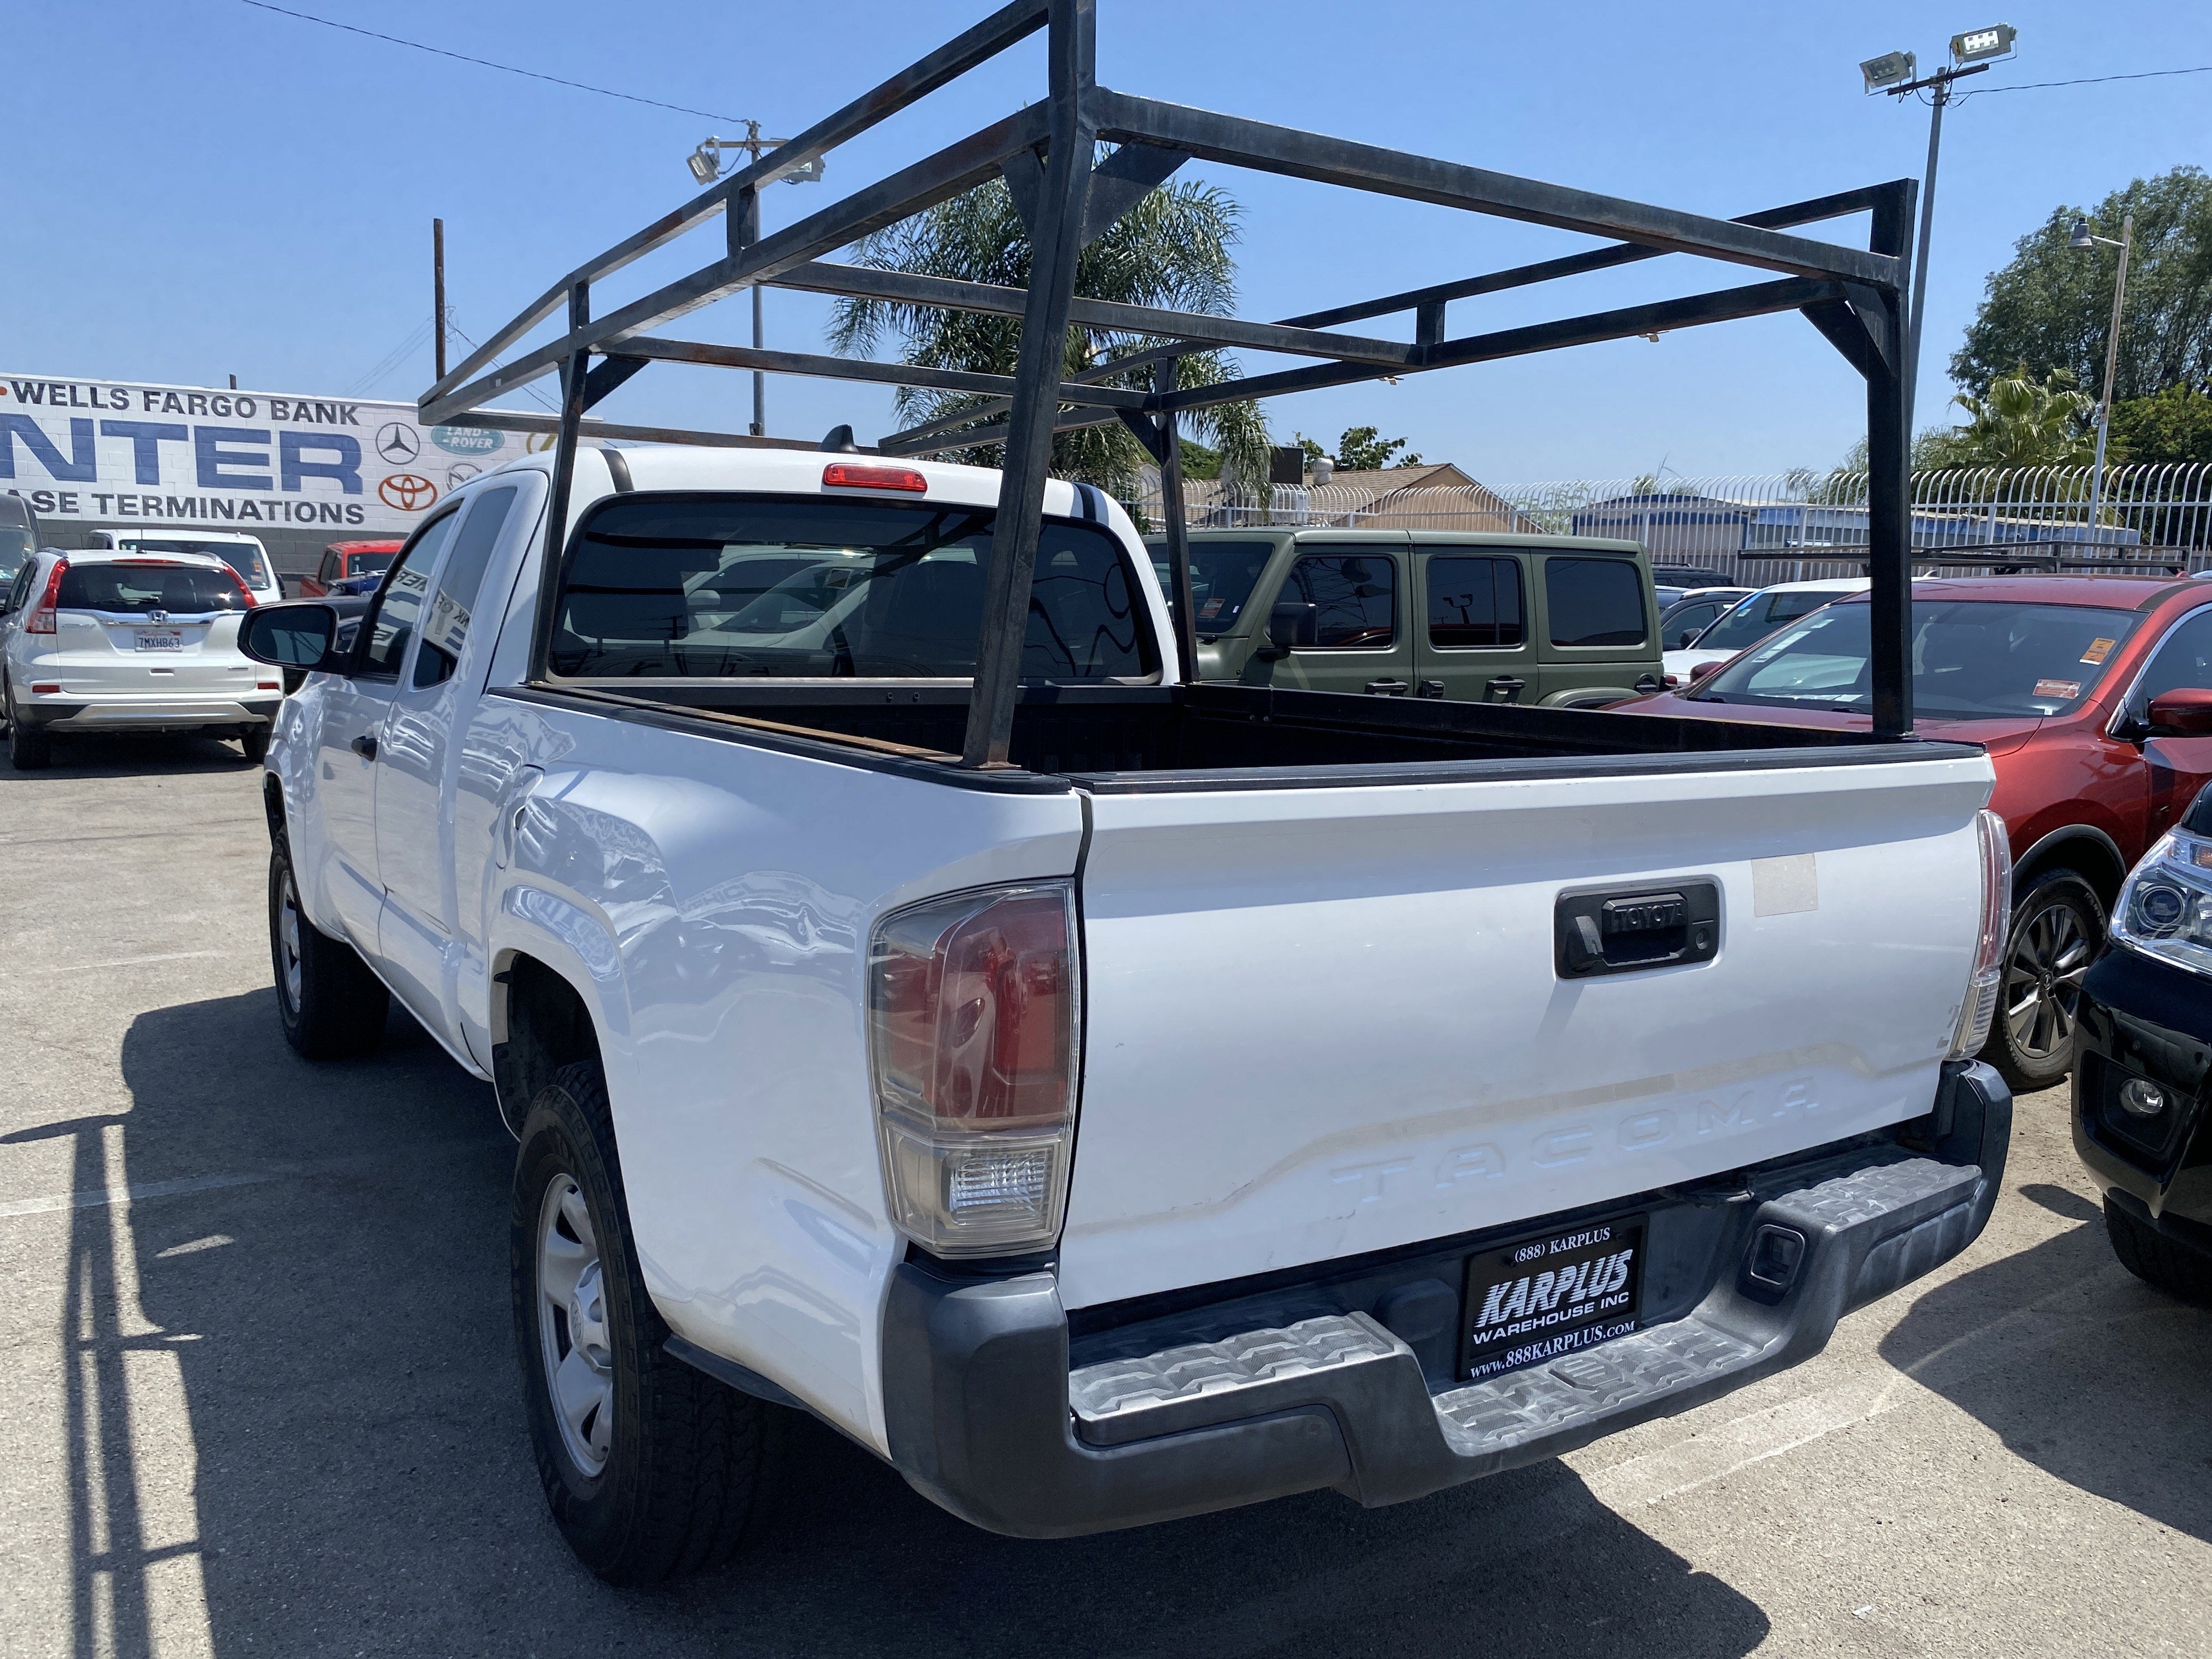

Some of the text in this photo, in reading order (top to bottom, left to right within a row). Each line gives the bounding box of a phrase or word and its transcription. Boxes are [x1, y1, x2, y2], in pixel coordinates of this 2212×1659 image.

[10, 381, 360, 426] WELLS FARGO BANK
[91, 493, 365, 525] TERMINATIONS
[1611, 902, 1686, 932] TOYOTA
[1329, 1075, 1822, 1203] TACOMA
[1515, 1227, 1610, 1262] (888) KARPLUS
[1474, 1249, 1633, 1328] KARPLUS
[1472, 1291, 1629, 1345] WAREHOUSE INC
